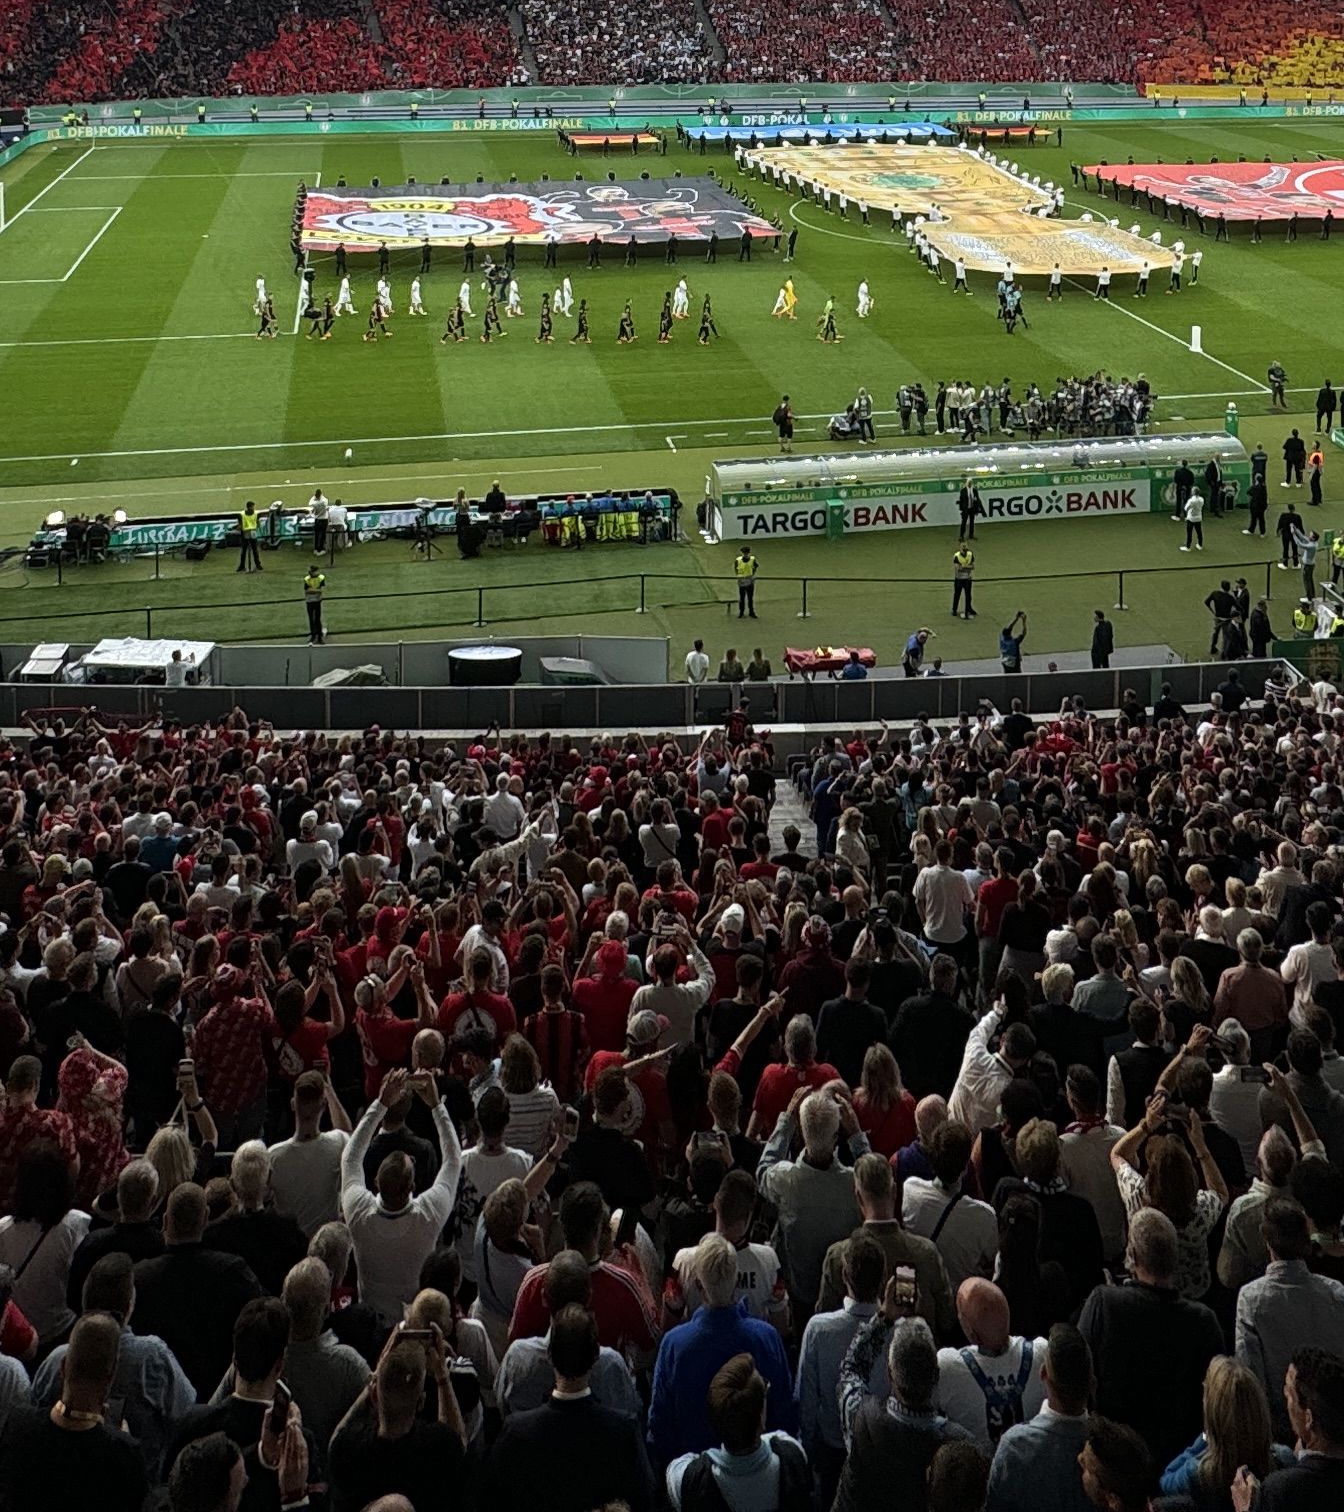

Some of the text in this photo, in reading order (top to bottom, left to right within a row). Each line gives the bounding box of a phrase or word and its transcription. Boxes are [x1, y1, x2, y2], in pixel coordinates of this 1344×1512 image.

[742, 115, 810, 126] DFB-POKAL
[976, 111, 1072, 121] DFB-POKALFINALE
[473, 118, 583, 130] DFB-POKALFINALE
[67, 125, 188, 138] DFB-POKALFINALE
[1066, 488, 1137, 513] BANK
[737, 502, 928, 536] TARGO BANK
